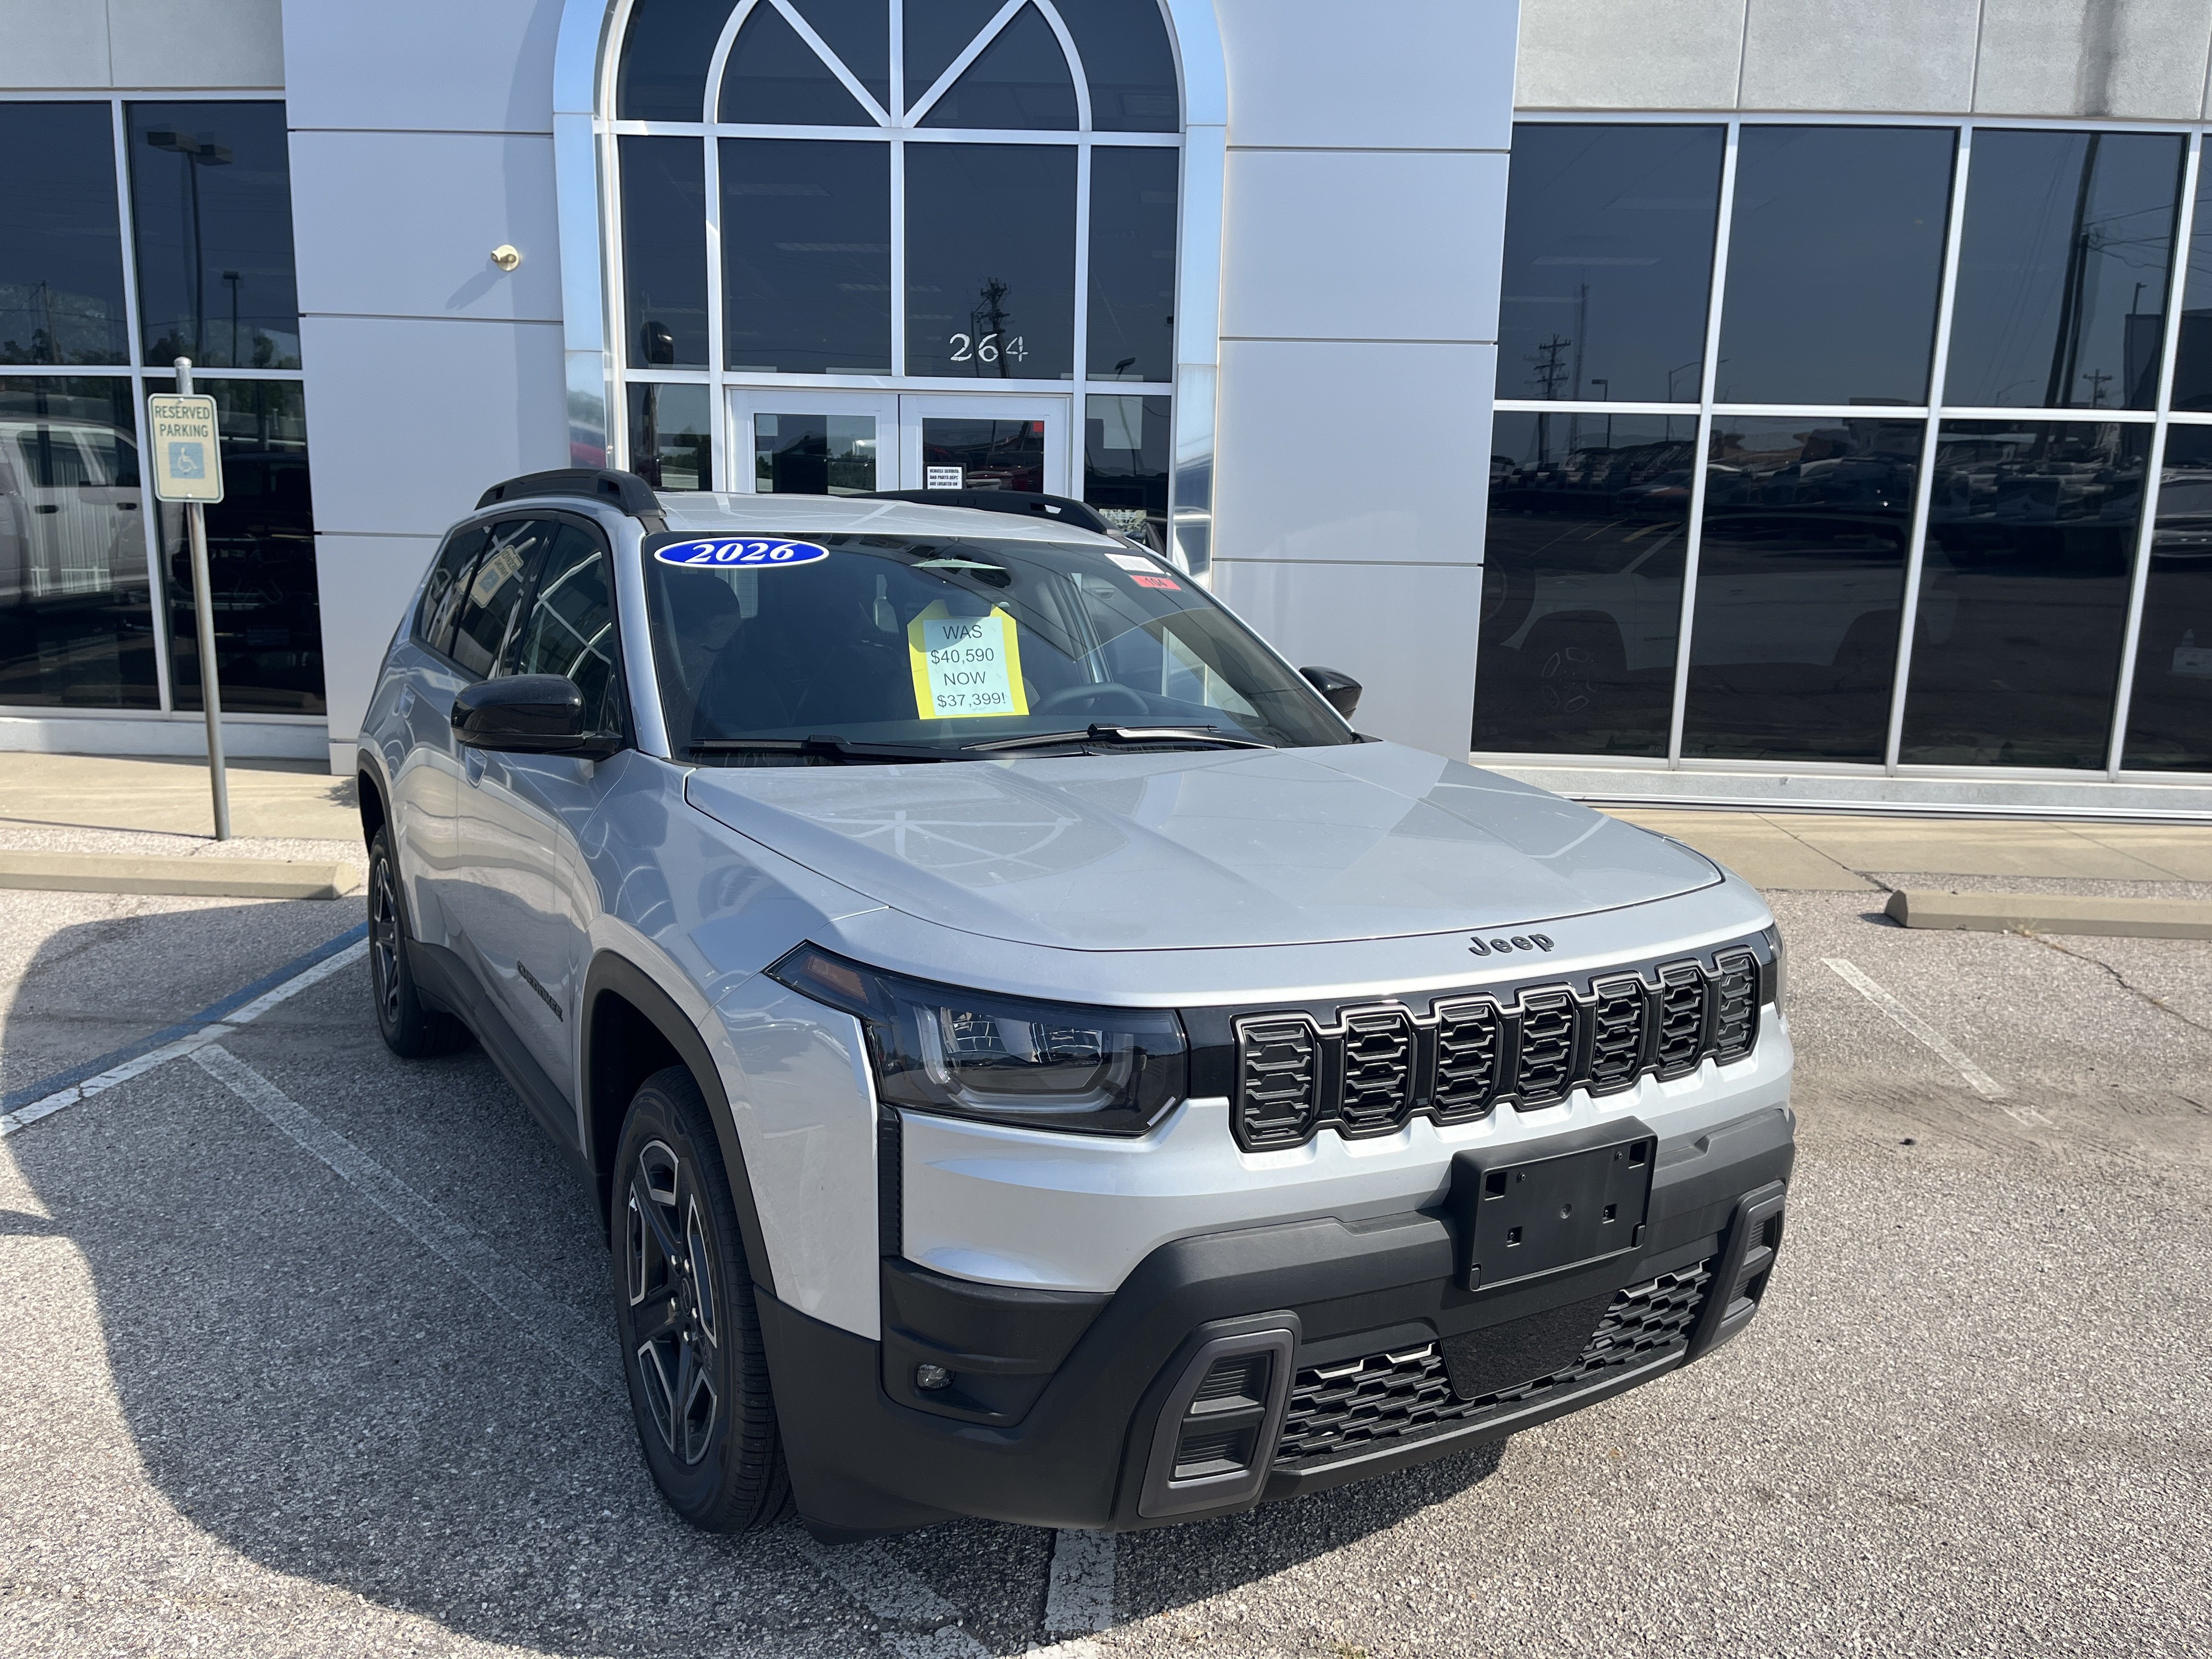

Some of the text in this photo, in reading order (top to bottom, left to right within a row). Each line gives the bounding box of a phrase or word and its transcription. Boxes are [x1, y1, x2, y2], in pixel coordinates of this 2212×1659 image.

[950, 333, 1029, 362] 264
[155, 406, 210, 419] RESERVED
[159, 424, 208, 437] PARKING
[685, 542, 798, 562] 2026
[1145, 577, 1168, 588] 104
[943, 624, 983, 640] WAS
[931, 647, 994, 665] $40,590
[944, 671, 986, 686] NOW
[937, 692, 1006, 708] $37,399!
[1468, 933, 1555, 956] Jeep
